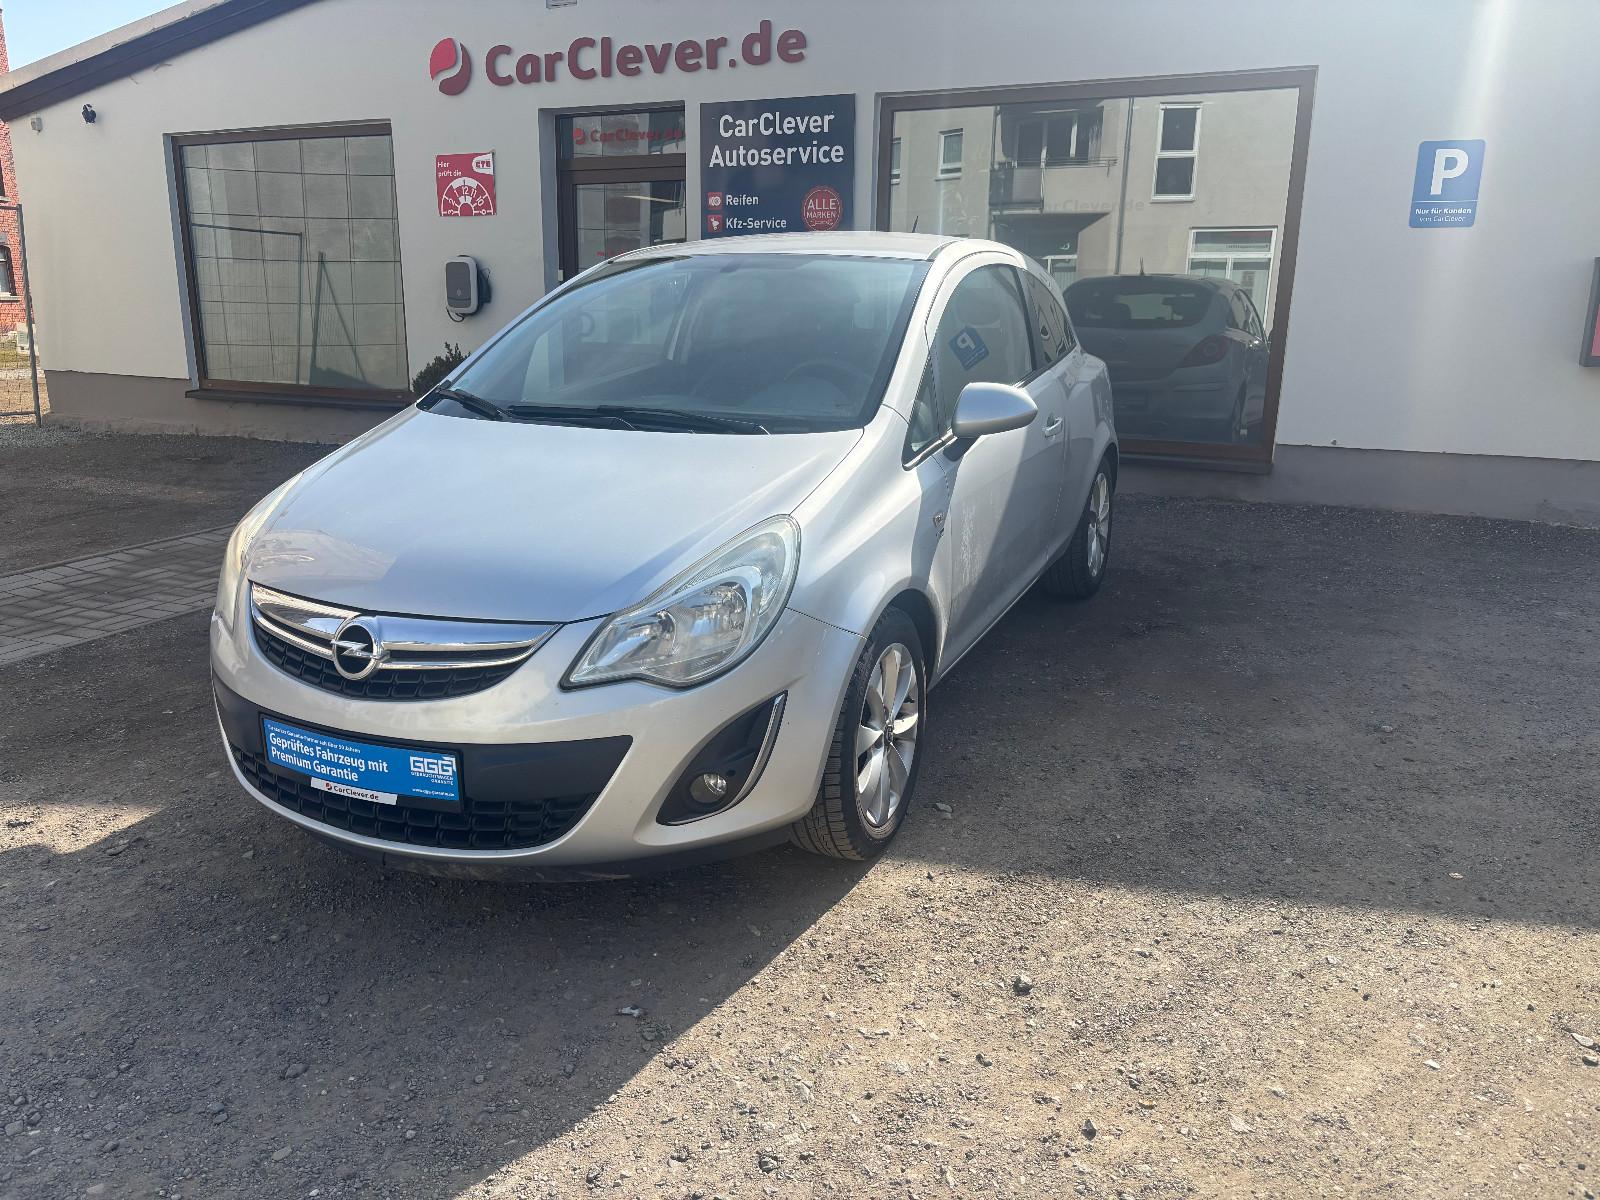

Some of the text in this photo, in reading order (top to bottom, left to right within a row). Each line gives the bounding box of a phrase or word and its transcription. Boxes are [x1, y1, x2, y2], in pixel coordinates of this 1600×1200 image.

[485, 19, 808, 86] CarClever.de
[719, 111, 835, 138] CarClever
[709, 140, 844, 168] Autoservice
[1430, 148, 1469, 196] P
[726, 194, 759, 206] Reifen
[807, 199, 837, 210] ALLE
[806, 211, 837, 219] MARKEN
[1415, 207, 1430, 215] Nur
[1430, 207, 1442, 215] für
[726, 216, 787, 229] Kfz-Service
[269, 733, 389, 773] Geprüftes Fahrzeug mit
[271, 748, 359, 782] Premium Garantie
[409, 755, 455, 775] GGG
[333, 785, 379, 801] CarClever.de
